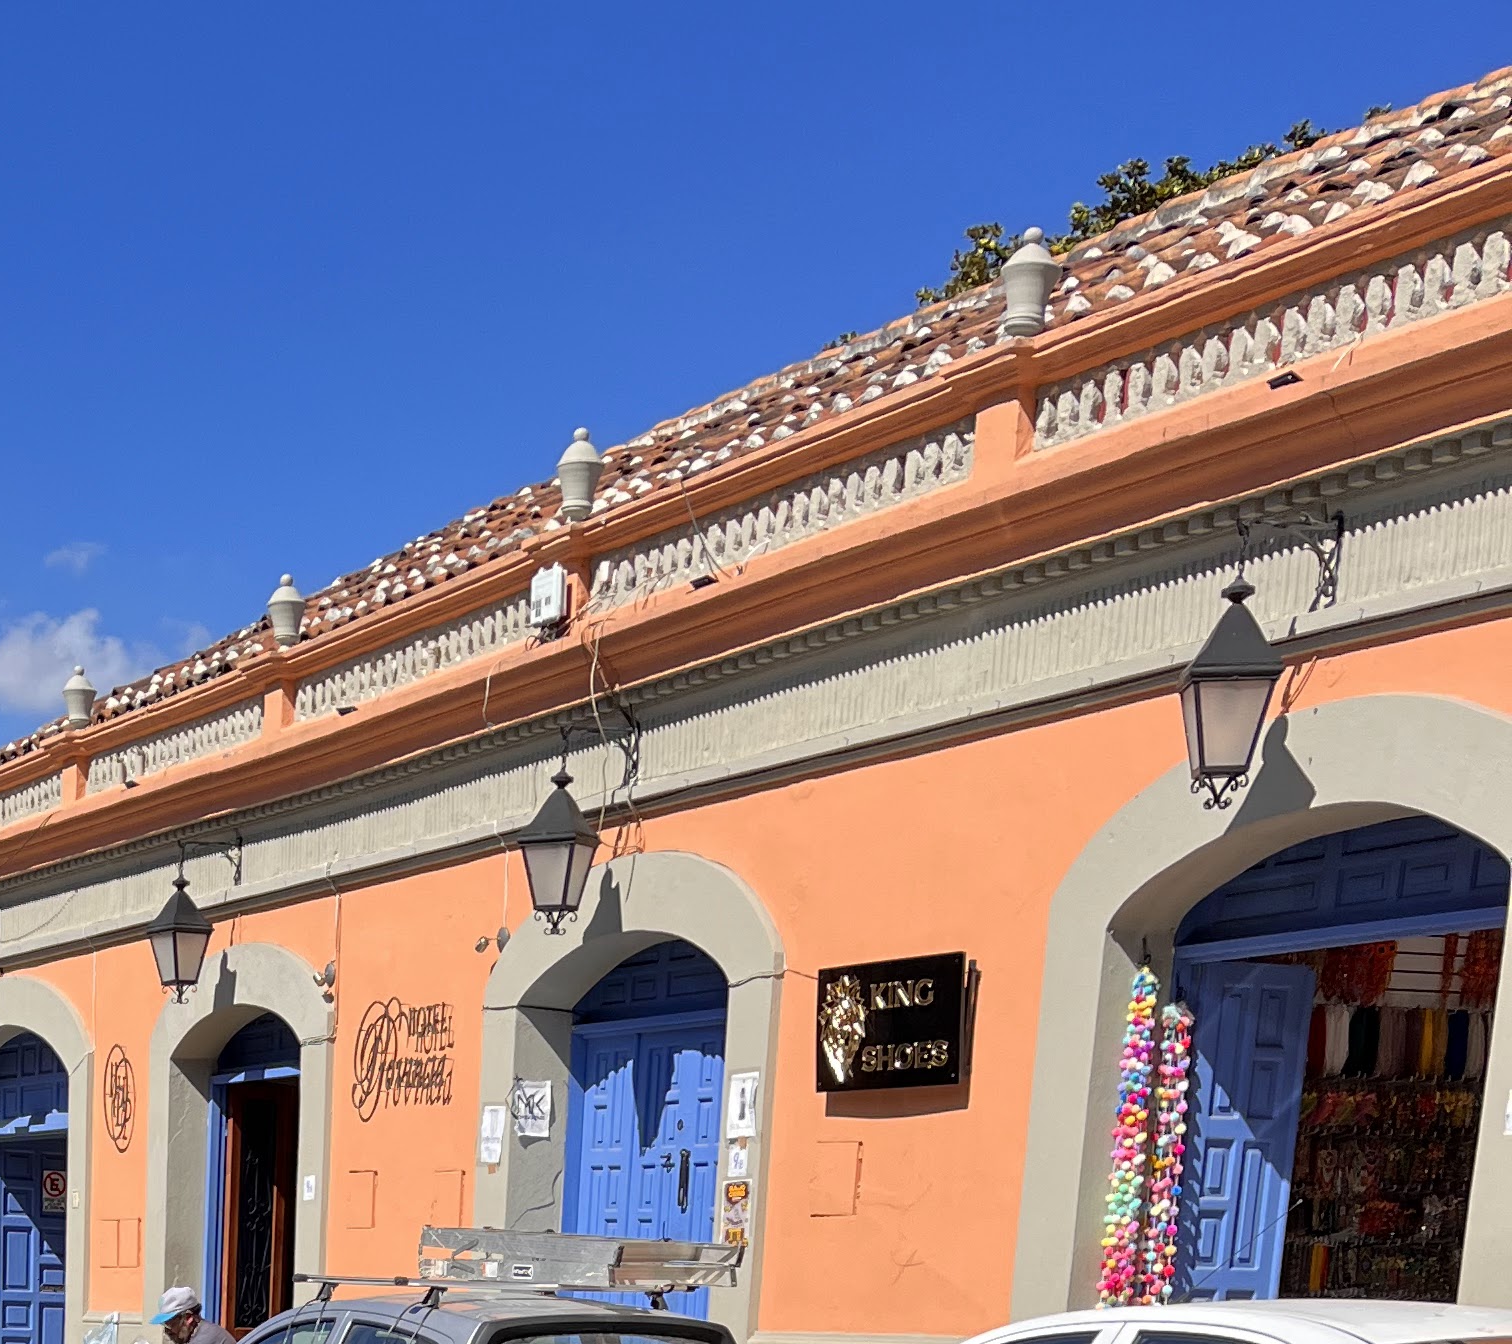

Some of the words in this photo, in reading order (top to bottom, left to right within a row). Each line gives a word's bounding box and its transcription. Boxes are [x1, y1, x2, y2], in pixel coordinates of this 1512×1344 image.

[869, 978, 934, 1010] KING
[408, 1002, 449, 1038] HOTEL
[860, 1039, 949, 1072] SHOES
